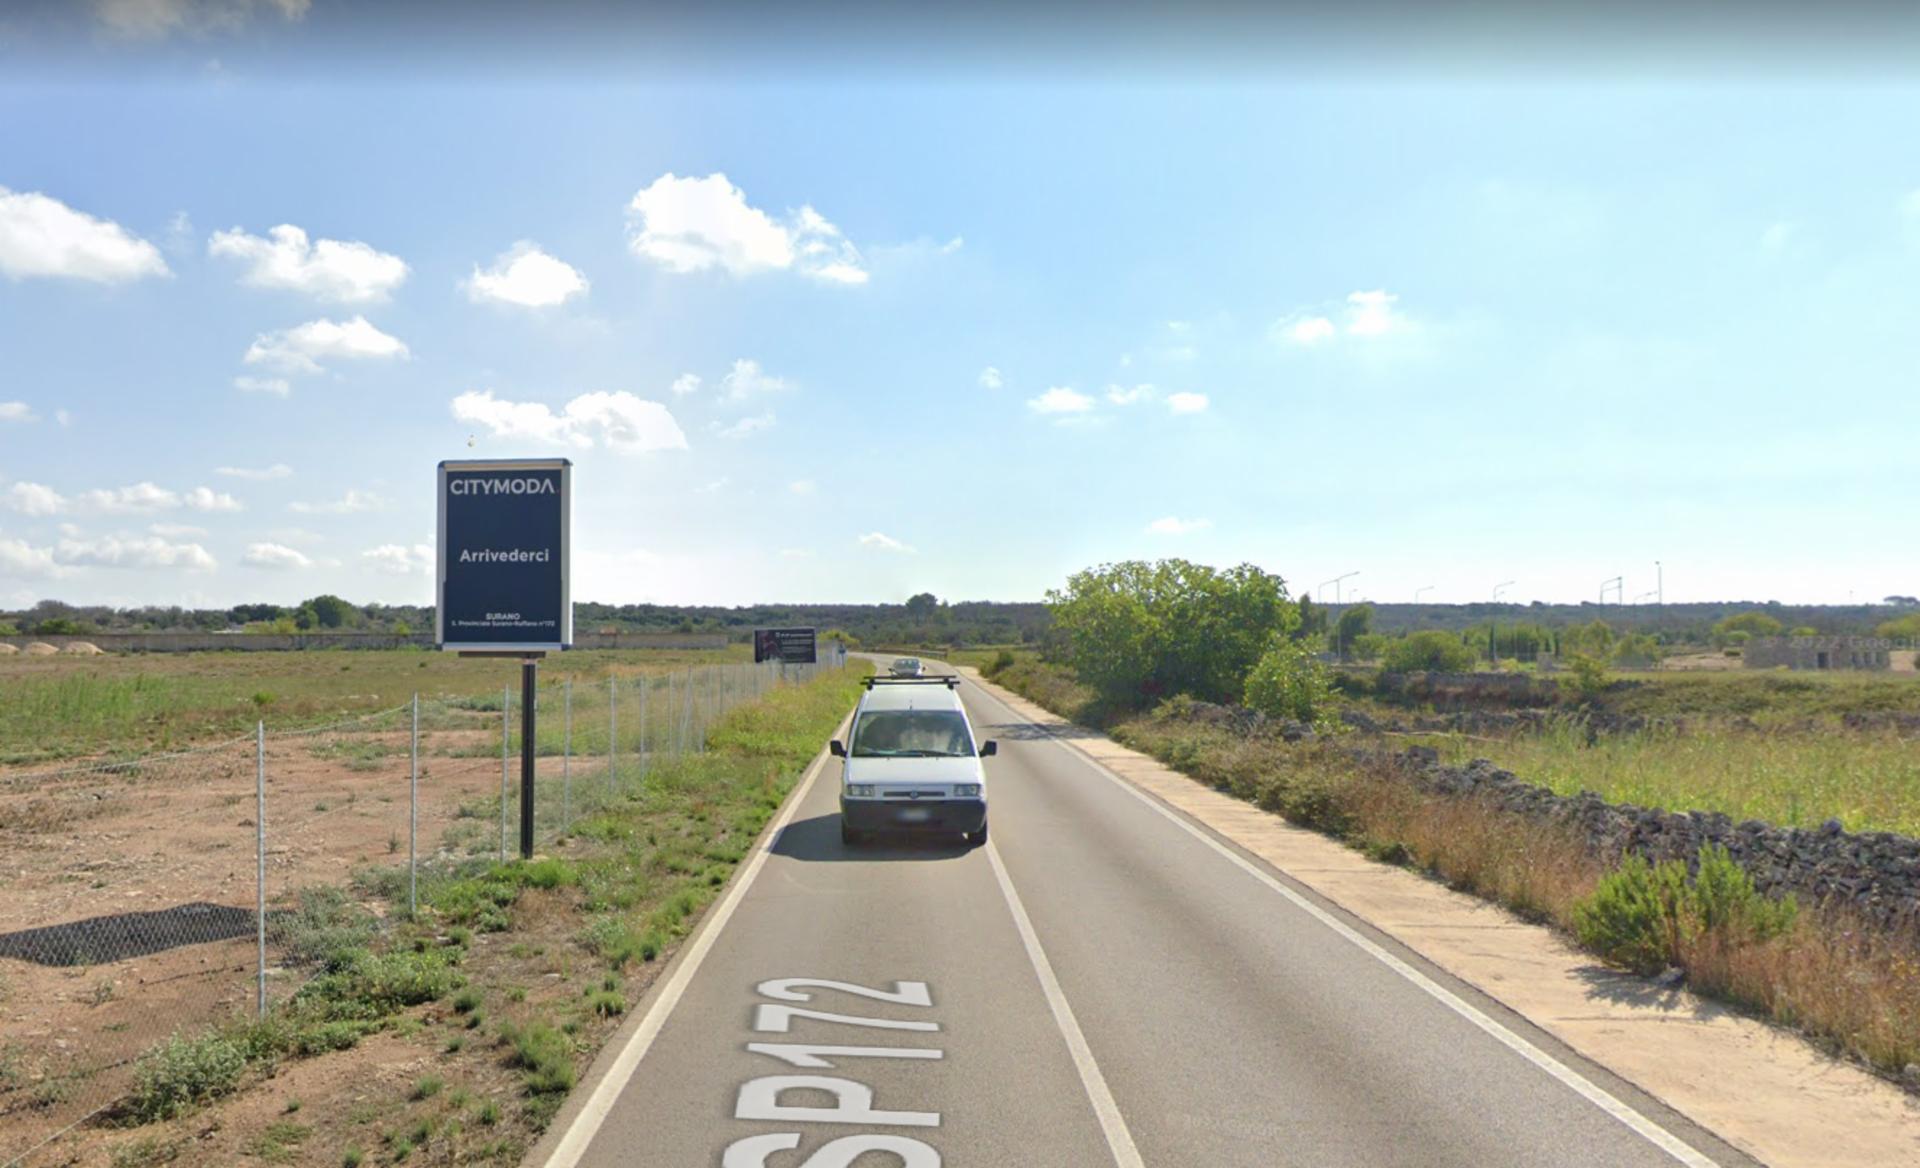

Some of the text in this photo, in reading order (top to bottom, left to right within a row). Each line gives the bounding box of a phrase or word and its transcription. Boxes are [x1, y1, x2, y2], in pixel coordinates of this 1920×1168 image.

[450, 478, 555, 496] CITYMODA
[459, 549, 550, 563] Arrivederci
[485, 612, 521, 621] SURANO
[721, 977, 944, 1168] SP172
